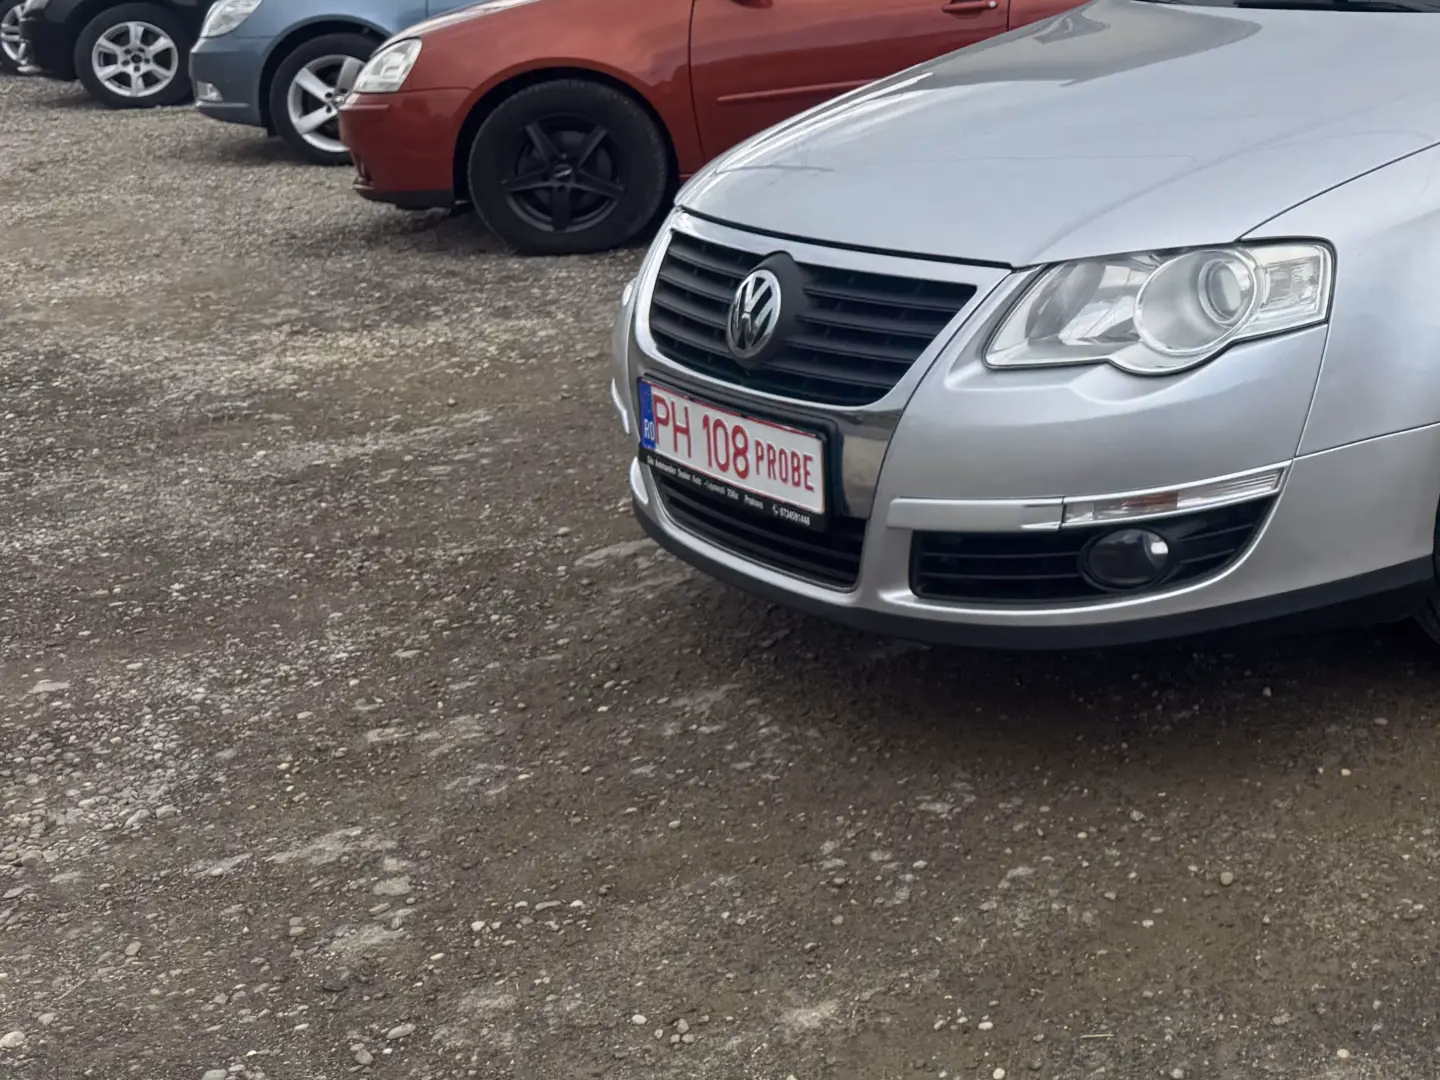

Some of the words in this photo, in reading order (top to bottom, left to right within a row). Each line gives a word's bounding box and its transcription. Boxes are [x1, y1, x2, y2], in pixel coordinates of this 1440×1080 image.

[644, 418, 655, 441] RO
[652, 391, 691, 458] PH
[703, 414, 750, 480] 108
[755, 439, 815, 493] PROBE
